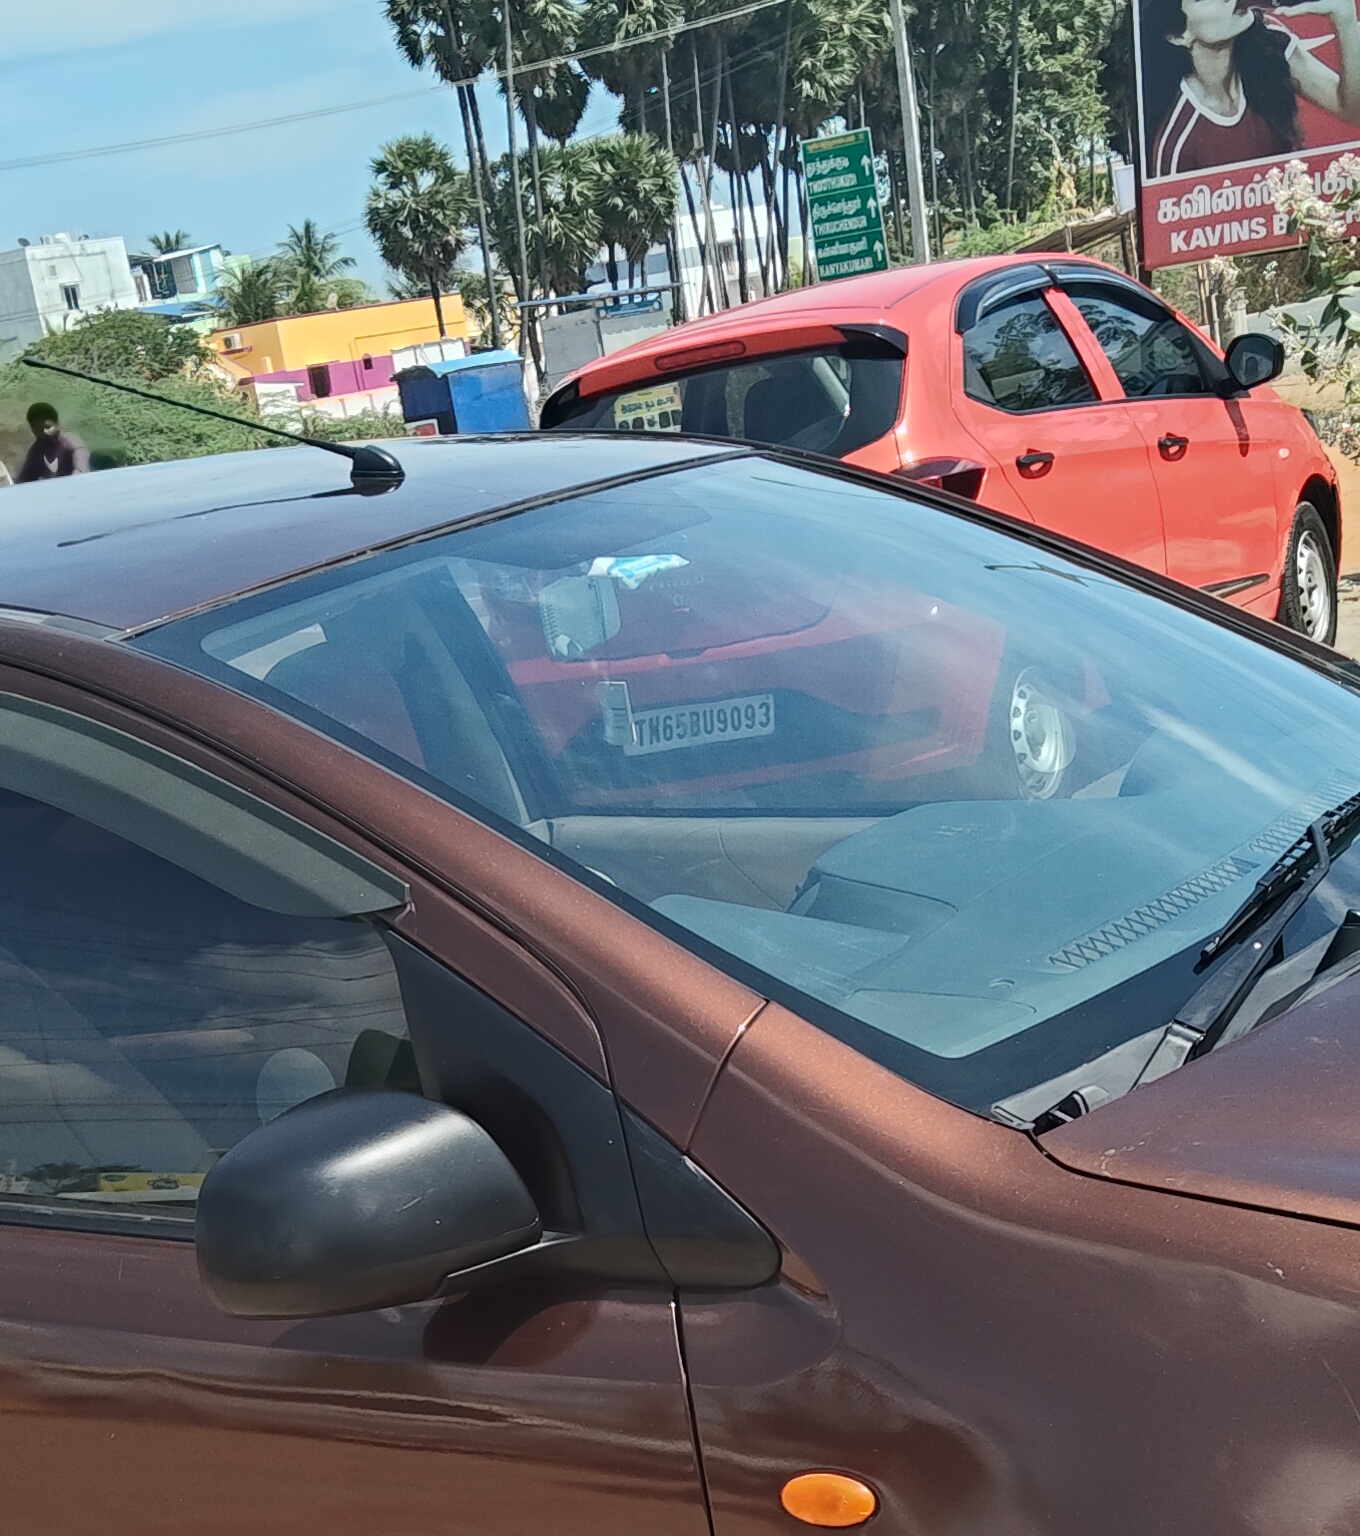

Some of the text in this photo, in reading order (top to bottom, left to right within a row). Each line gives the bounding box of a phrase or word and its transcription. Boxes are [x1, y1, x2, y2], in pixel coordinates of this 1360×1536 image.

[1157, 173, 1278, 224] கவின்ஸ்
[1170, 217, 1267, 254] KAVINS
[634, 701, 771, 747] TN65BU9093
